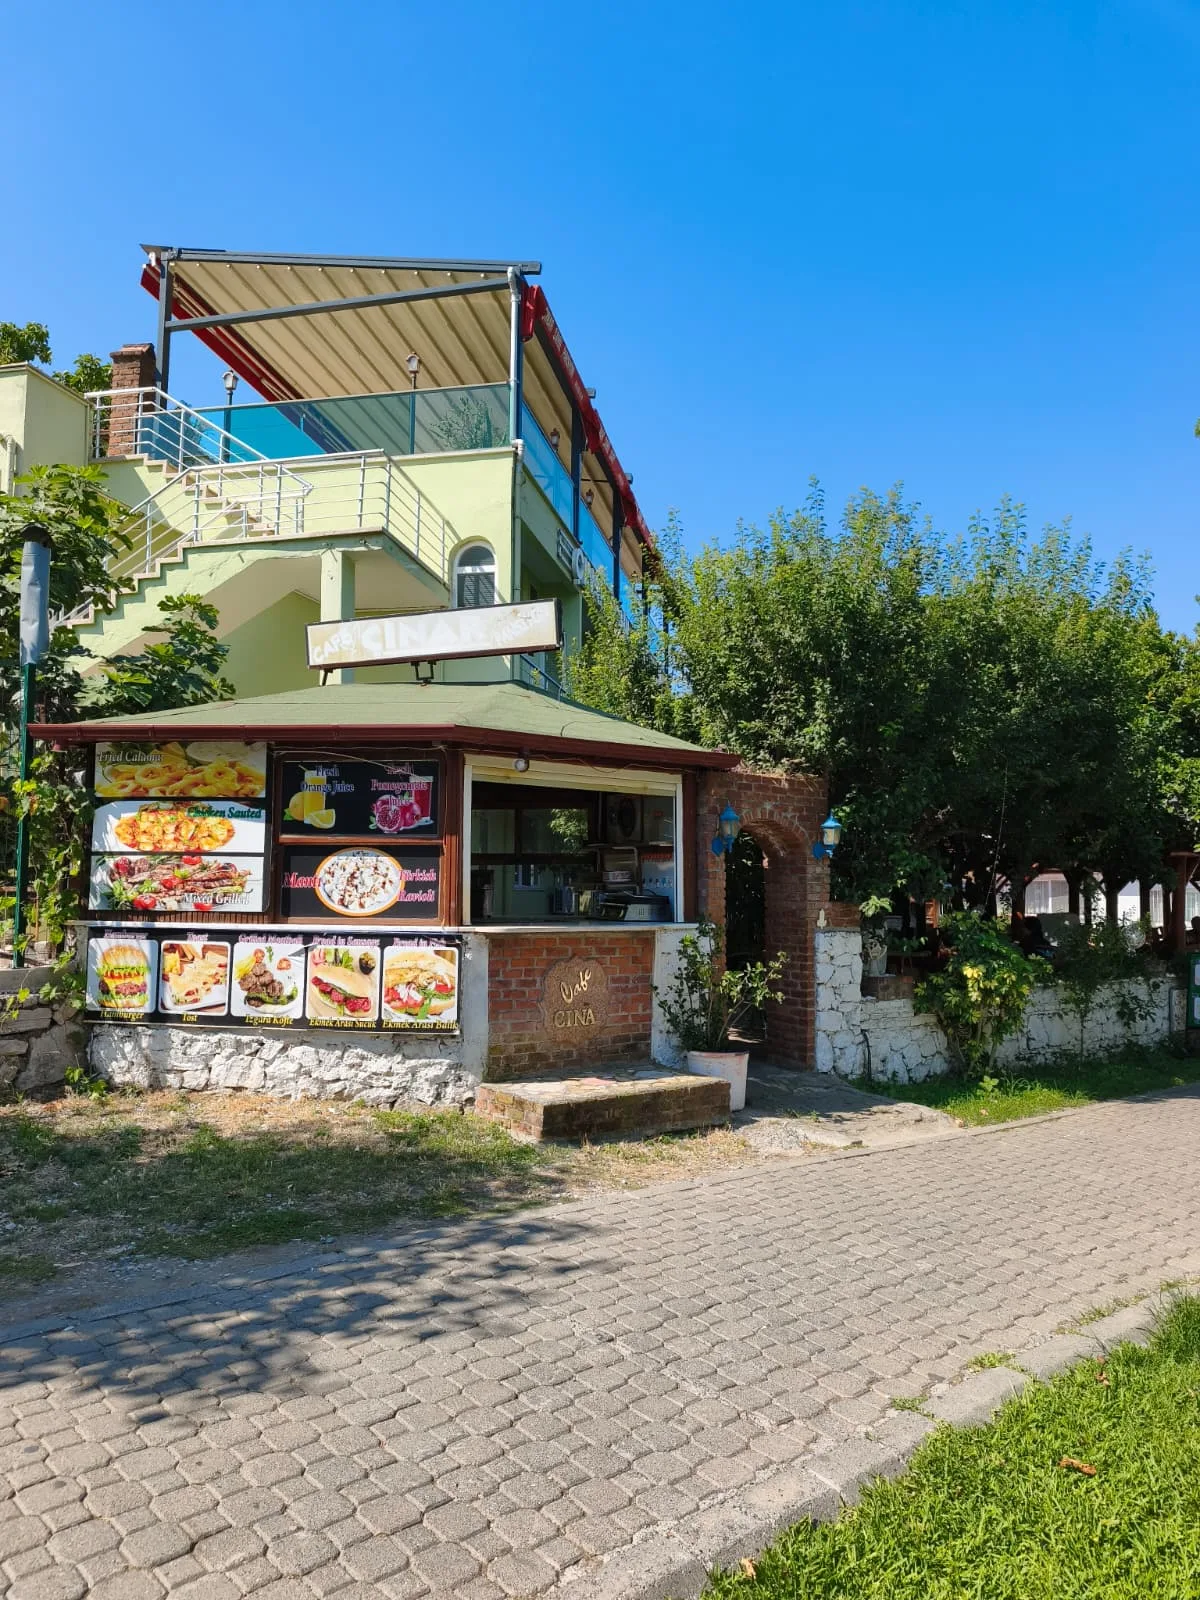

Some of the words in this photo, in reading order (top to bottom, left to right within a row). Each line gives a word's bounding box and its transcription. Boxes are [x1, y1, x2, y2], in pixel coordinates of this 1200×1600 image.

[315, 765, 340, 777] Fresh
[301, 781, 331, 793] Orange
[331, 779, 355, 796] Juice
[186, 806, 226, 818] Chicken
[100, 1009, 145, 1021] Hamburger
[181, 1013, 198, 1023] Tost
